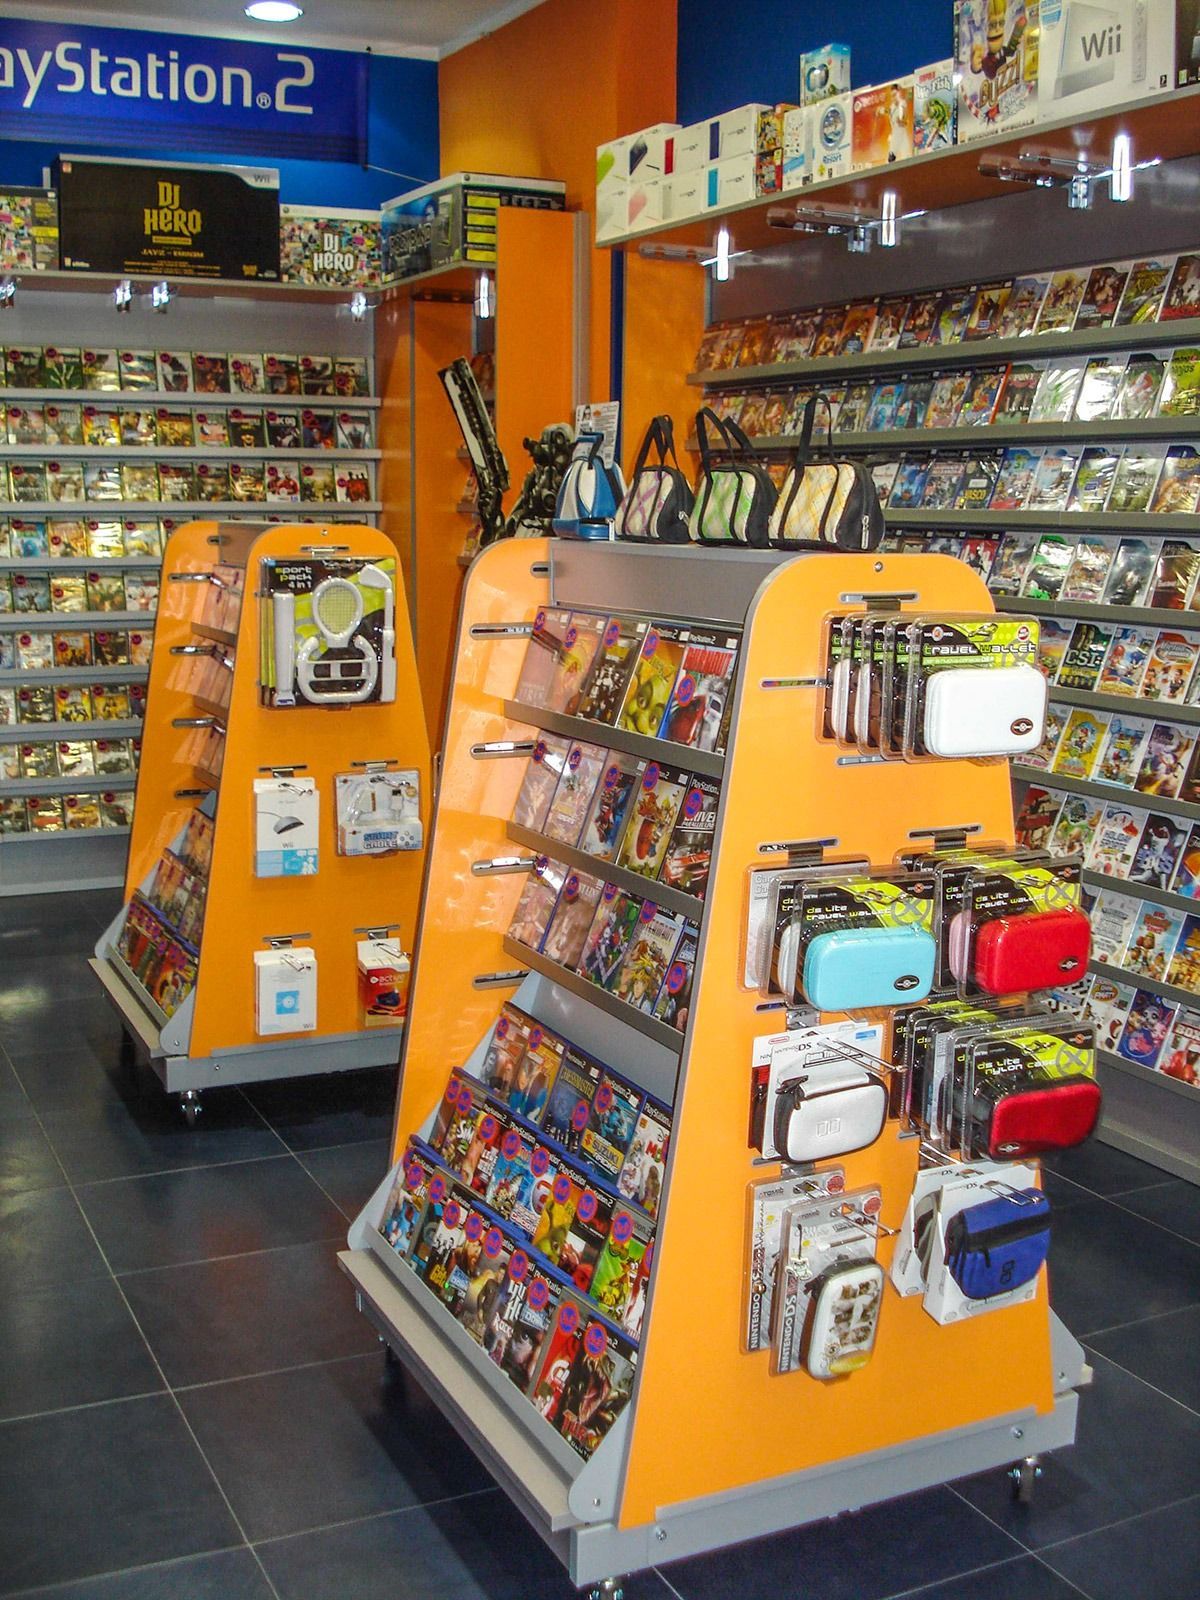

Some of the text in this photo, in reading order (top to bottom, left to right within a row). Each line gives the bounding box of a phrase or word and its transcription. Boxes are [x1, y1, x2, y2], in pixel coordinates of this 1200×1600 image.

[1081, 24, 1122, 62] Wii
[157, 181, 181, 210] DJ
[323, 233, 339, 253] DJ
[798, 1042, 812, 1051] DS
[751, 1293, 761, 1349] NINTENDO
[780, 1294, 797, 1372] NINTENDO DS
